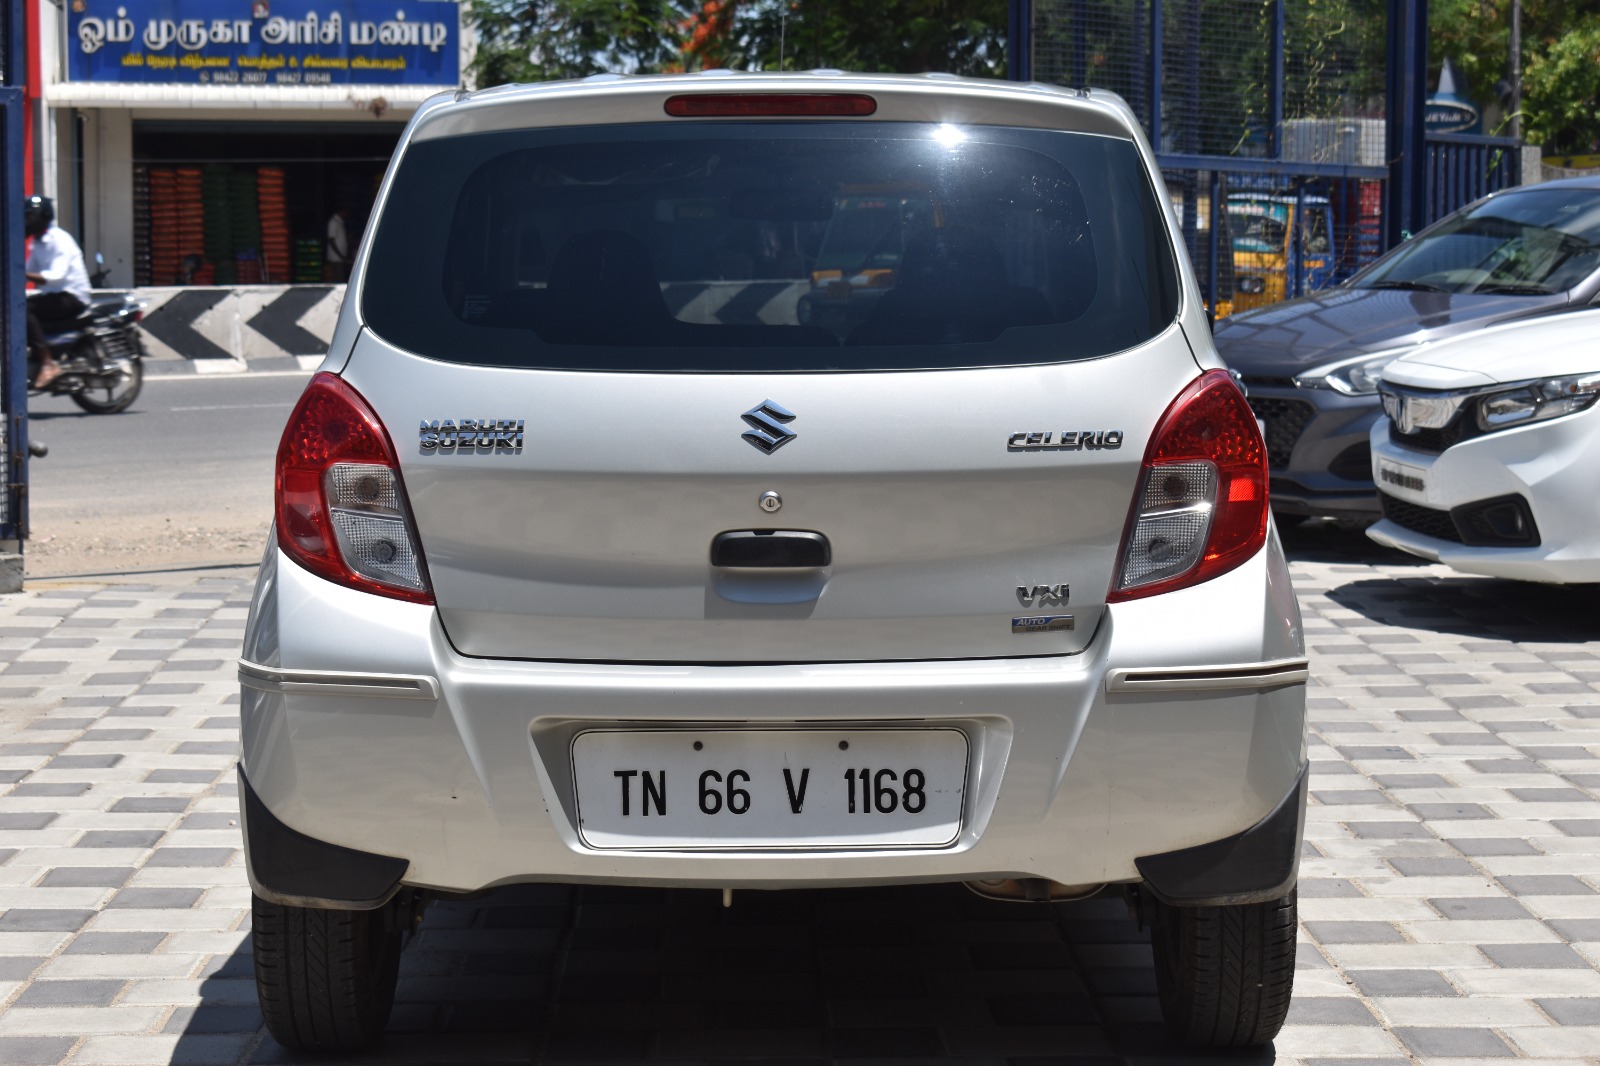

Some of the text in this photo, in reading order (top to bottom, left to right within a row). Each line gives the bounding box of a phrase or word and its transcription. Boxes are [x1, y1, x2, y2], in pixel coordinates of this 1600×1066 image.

[78, 6, 447, 54] ஓம் முருகா அரிசி மண்டி
[420, 419, 525, 432] MARUTI
[420, 432, 524, 449] SUZUKI
[1008, 430, 1123, 448] CELERIO
[1016, 618, 1046, 626] AUTO
[1048, 624, 1071, 632] SHIFT
[613, 768, 926, 817] TN 66 V 1168
